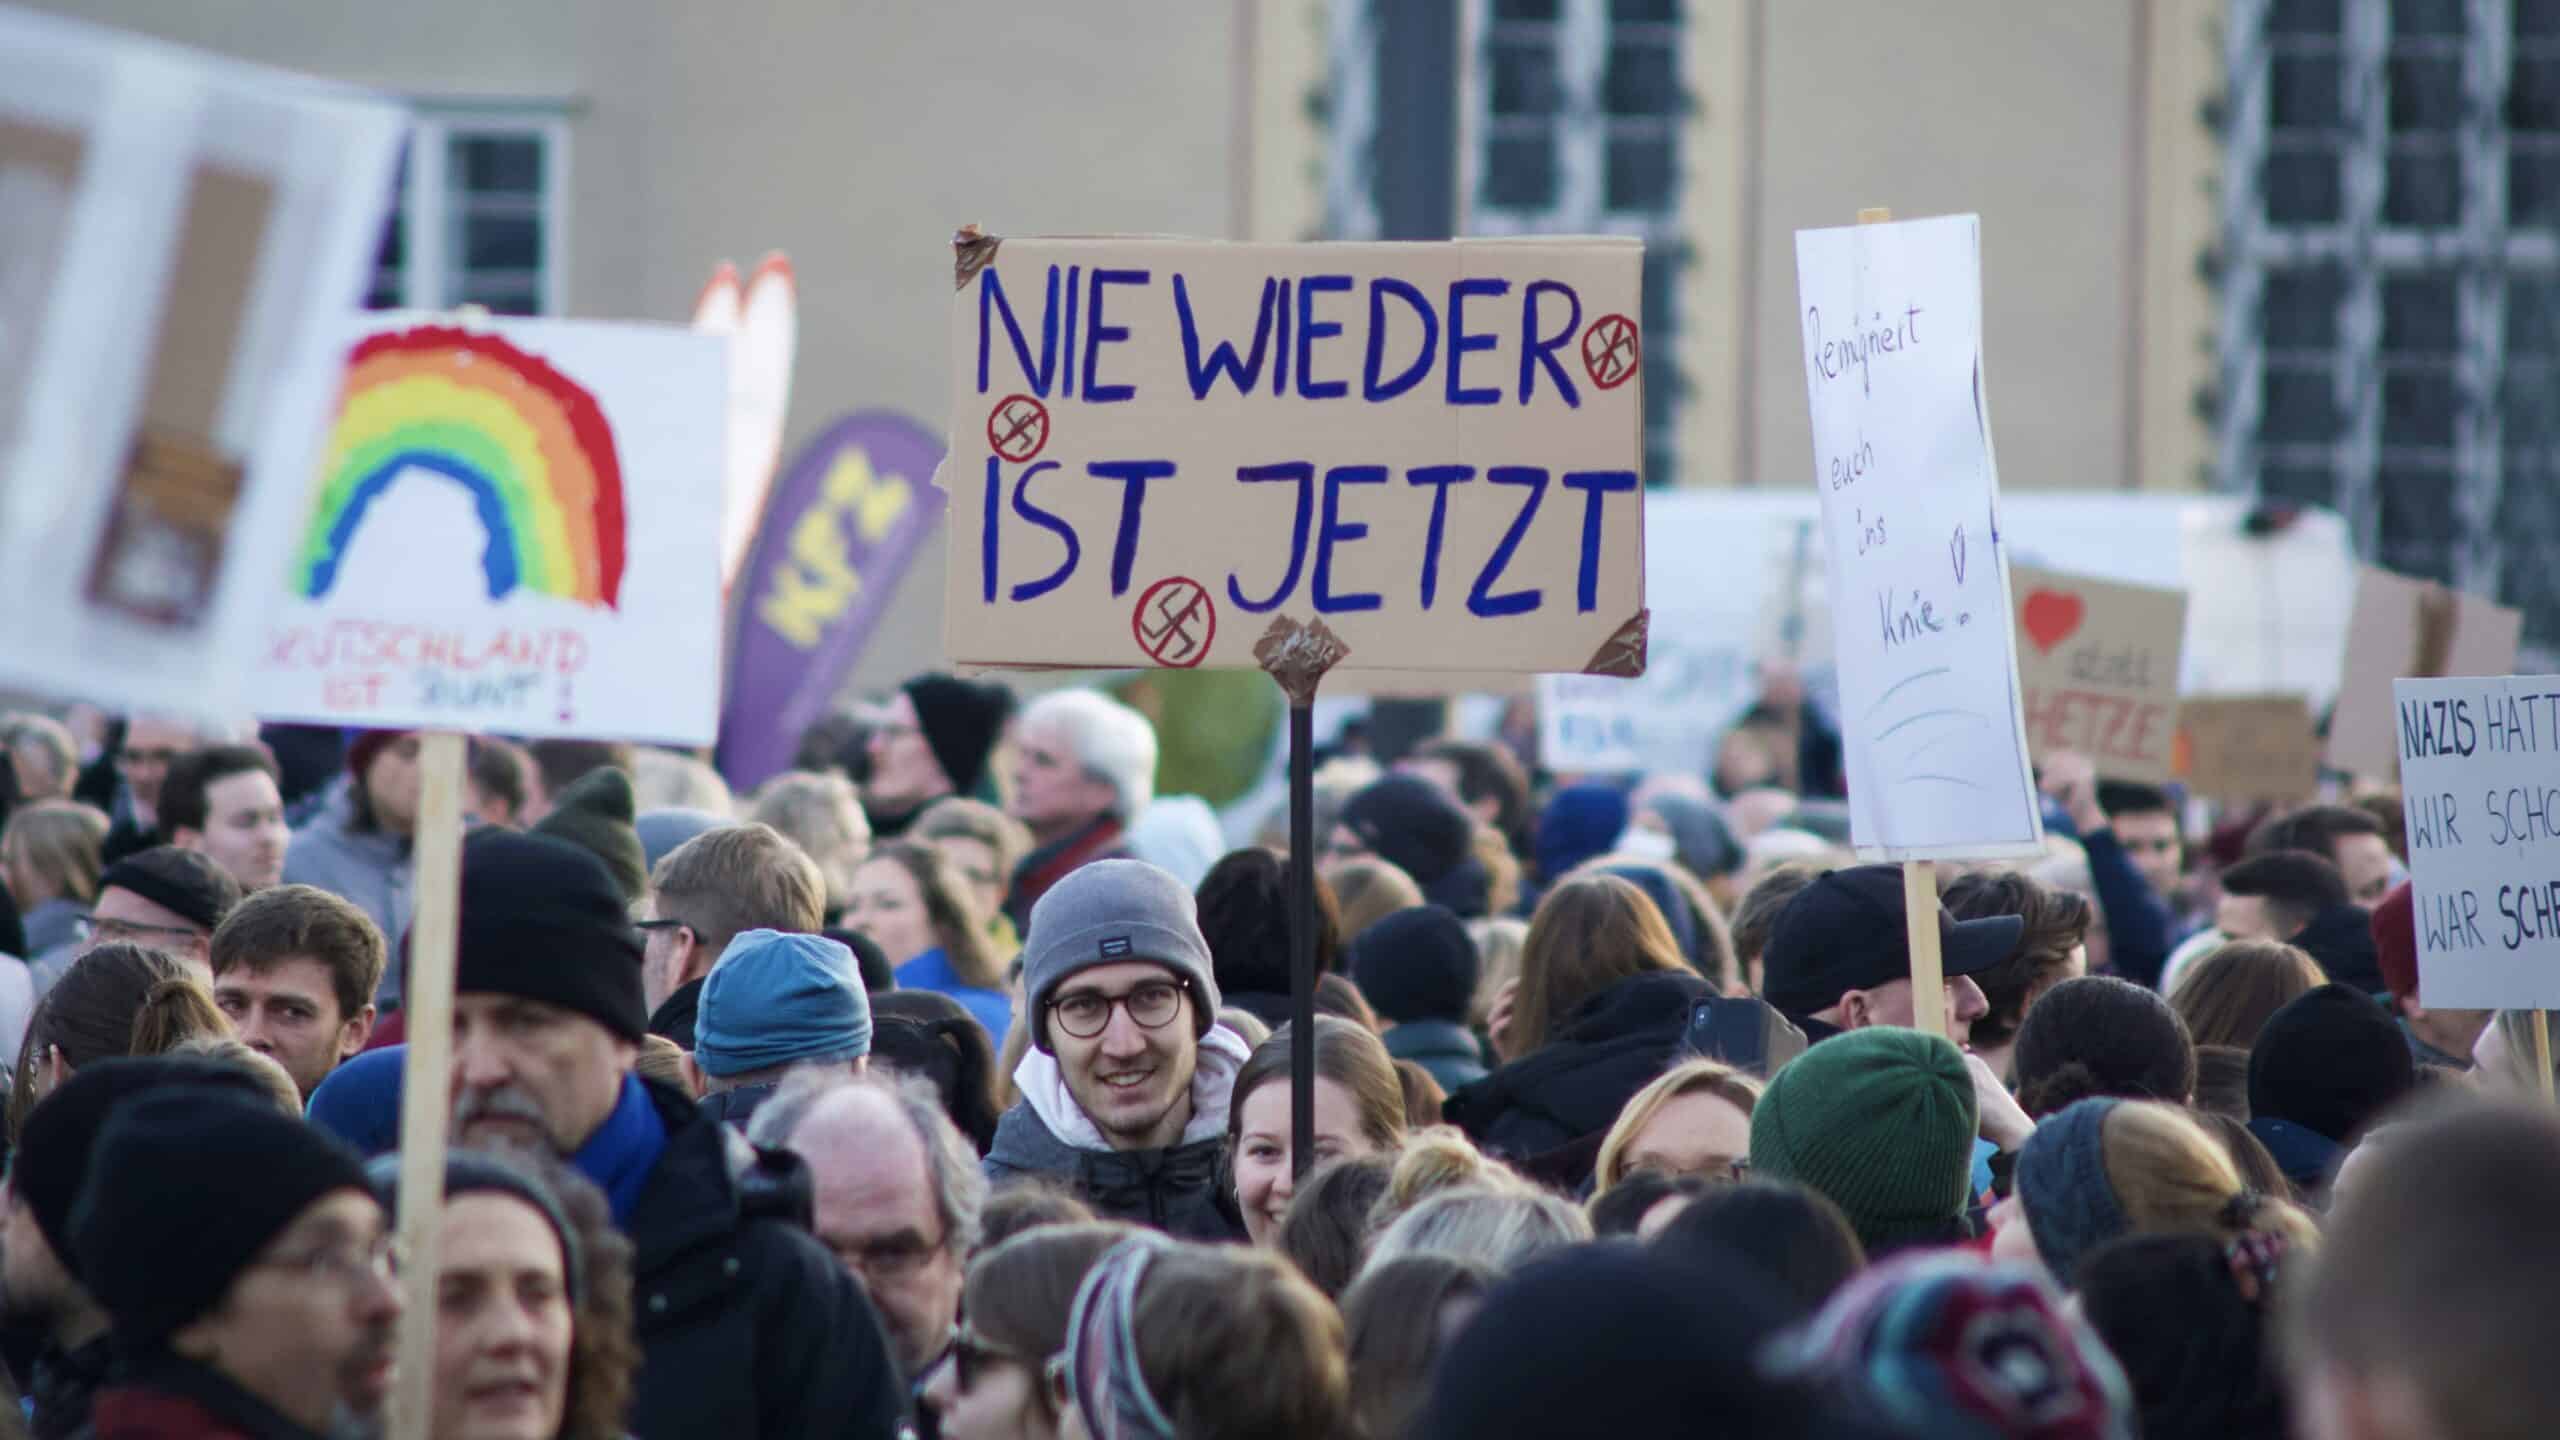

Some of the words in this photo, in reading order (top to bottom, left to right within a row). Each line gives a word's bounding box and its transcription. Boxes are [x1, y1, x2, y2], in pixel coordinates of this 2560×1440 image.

[977, 264, 1150, 404] NIE
[1172, 273, 1581, 408] WIEDER
[1831, 426, 1874, 490] euch
[982, 455, 1177, 603] IST
[1227, 461, 1639, 618] JETZT
[2401, 699, 2477, 760] NAZIS
[2410, 793, 2463, 848] WIR
[2422, 890, 2486, 952] WAR
